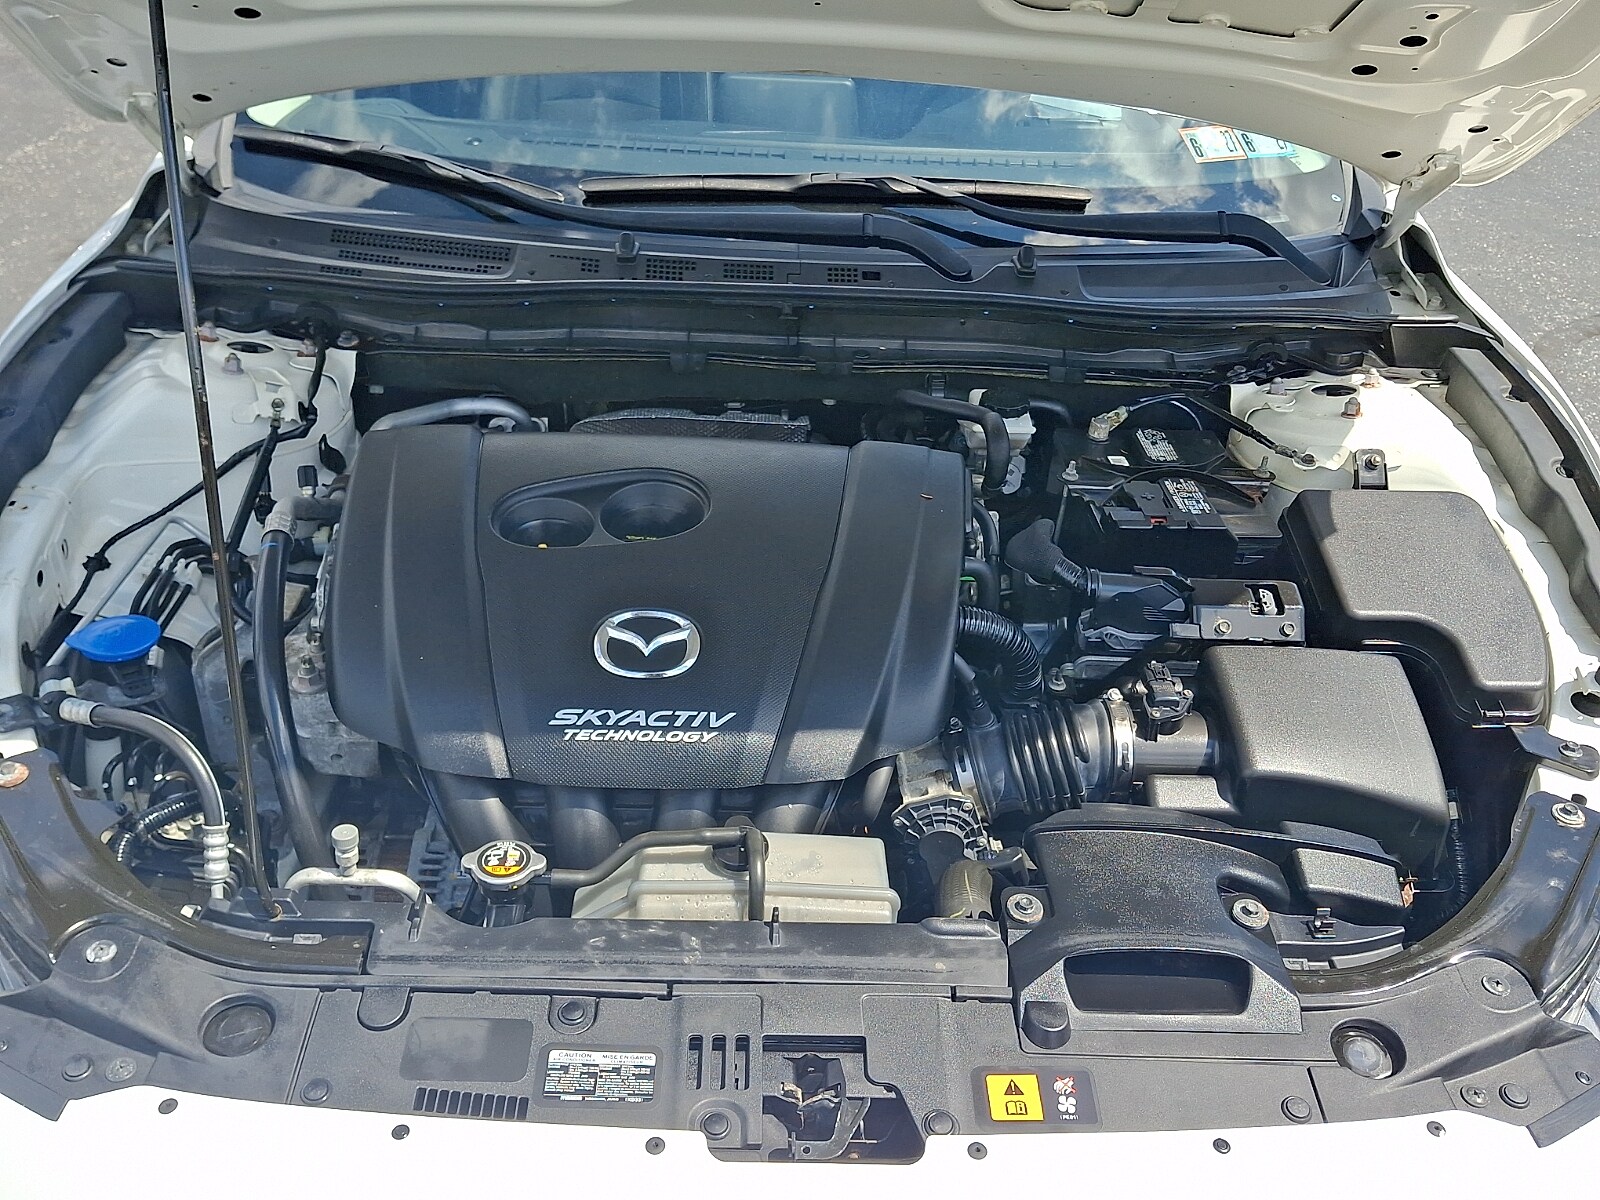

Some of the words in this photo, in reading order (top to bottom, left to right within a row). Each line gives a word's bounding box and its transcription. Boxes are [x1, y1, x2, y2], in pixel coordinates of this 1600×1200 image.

[1189, 138, 1204, 158] 6
[1240, 133, 1256, 152] 6
[548, 708, 737, 728] SKYACTIV
[563, 728, 719, 743] TECHNOLOGY
[558, 1051, 592, 1059] CAUTION
